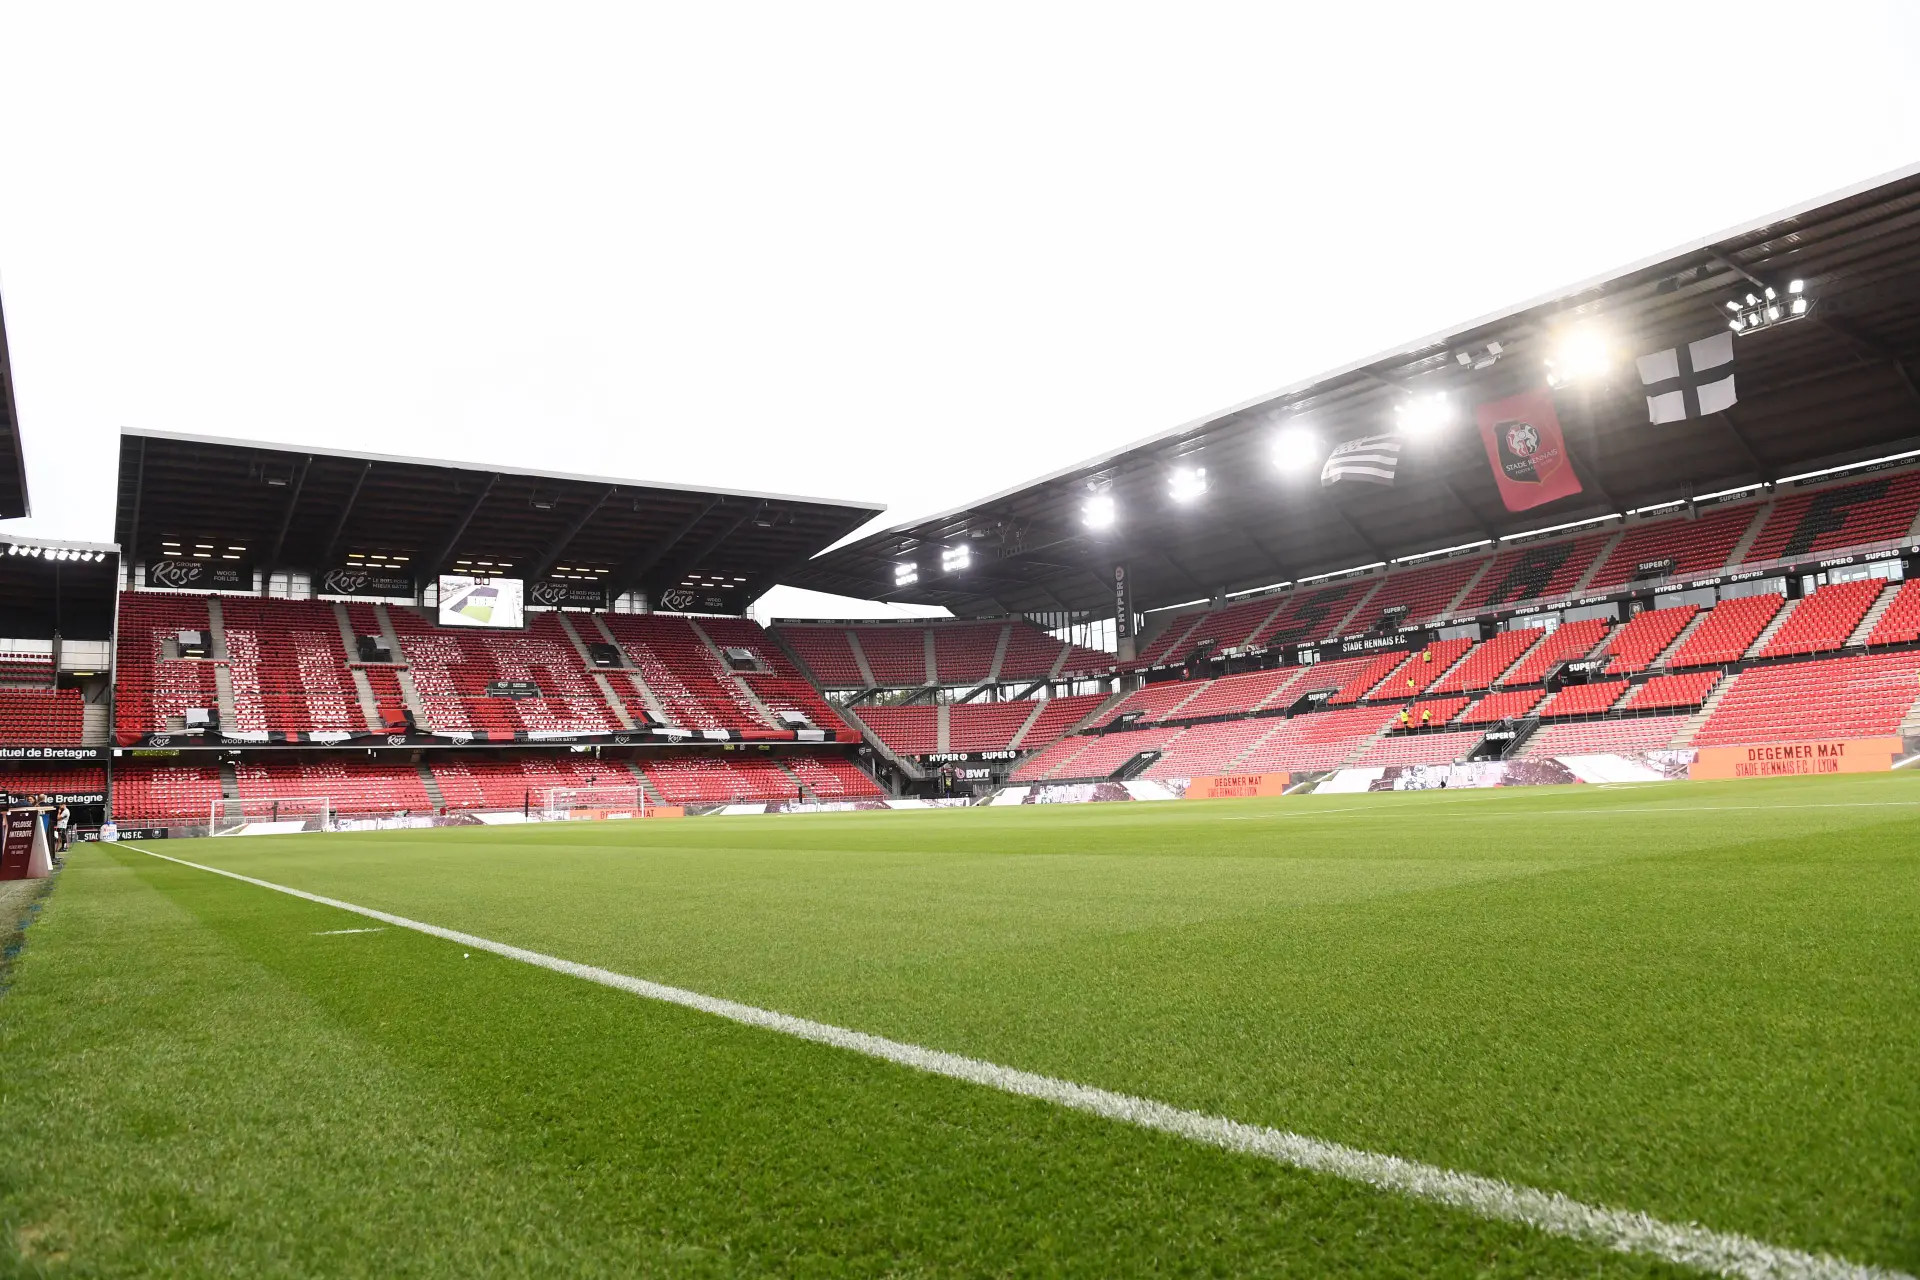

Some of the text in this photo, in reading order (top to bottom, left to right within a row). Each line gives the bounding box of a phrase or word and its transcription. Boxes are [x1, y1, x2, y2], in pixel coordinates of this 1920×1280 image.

[1506, 461, 1527, 472] STADE
[1719, 492, 1741, 502] SUPER
[1652, 508, 1672, 516] SUPER
[1865, 550, 1892, 560] SUPER
[1639, 561, 1663, 570] SUPER
[1820, 558, 1846, 567] HYPER
[1738, 570, 1764, 580] express
[1655, 585, 1677, 593] HYPER
[1692, 580, 1715, 588] SUPER
[661, 588, 694, 611] Rose
[1116, 581, 1125, 622] HYPER
[1342, 634, 1408, 652] STADE RENNAIS F.C.
[387, 735, 406, 746] Rose
[1486, 732, 1508, 740] SUPER
[149, 736, 170, 748] Rose
[0, 748, 97, 759] tuel de Bretagne
[1748, 744, 1844, 760] DEGEMER MAT
[1736, 762, 1759, 776] STADE
[1761, 760, 1794, 776] RENNAIS
[1818, 759, 1838, 772] LYON
[966, 769, 990, 778] BWT
[1215, 776, 1262, 787] DEGEMER MAT
[56, 795, 103, 804] Bretagne
